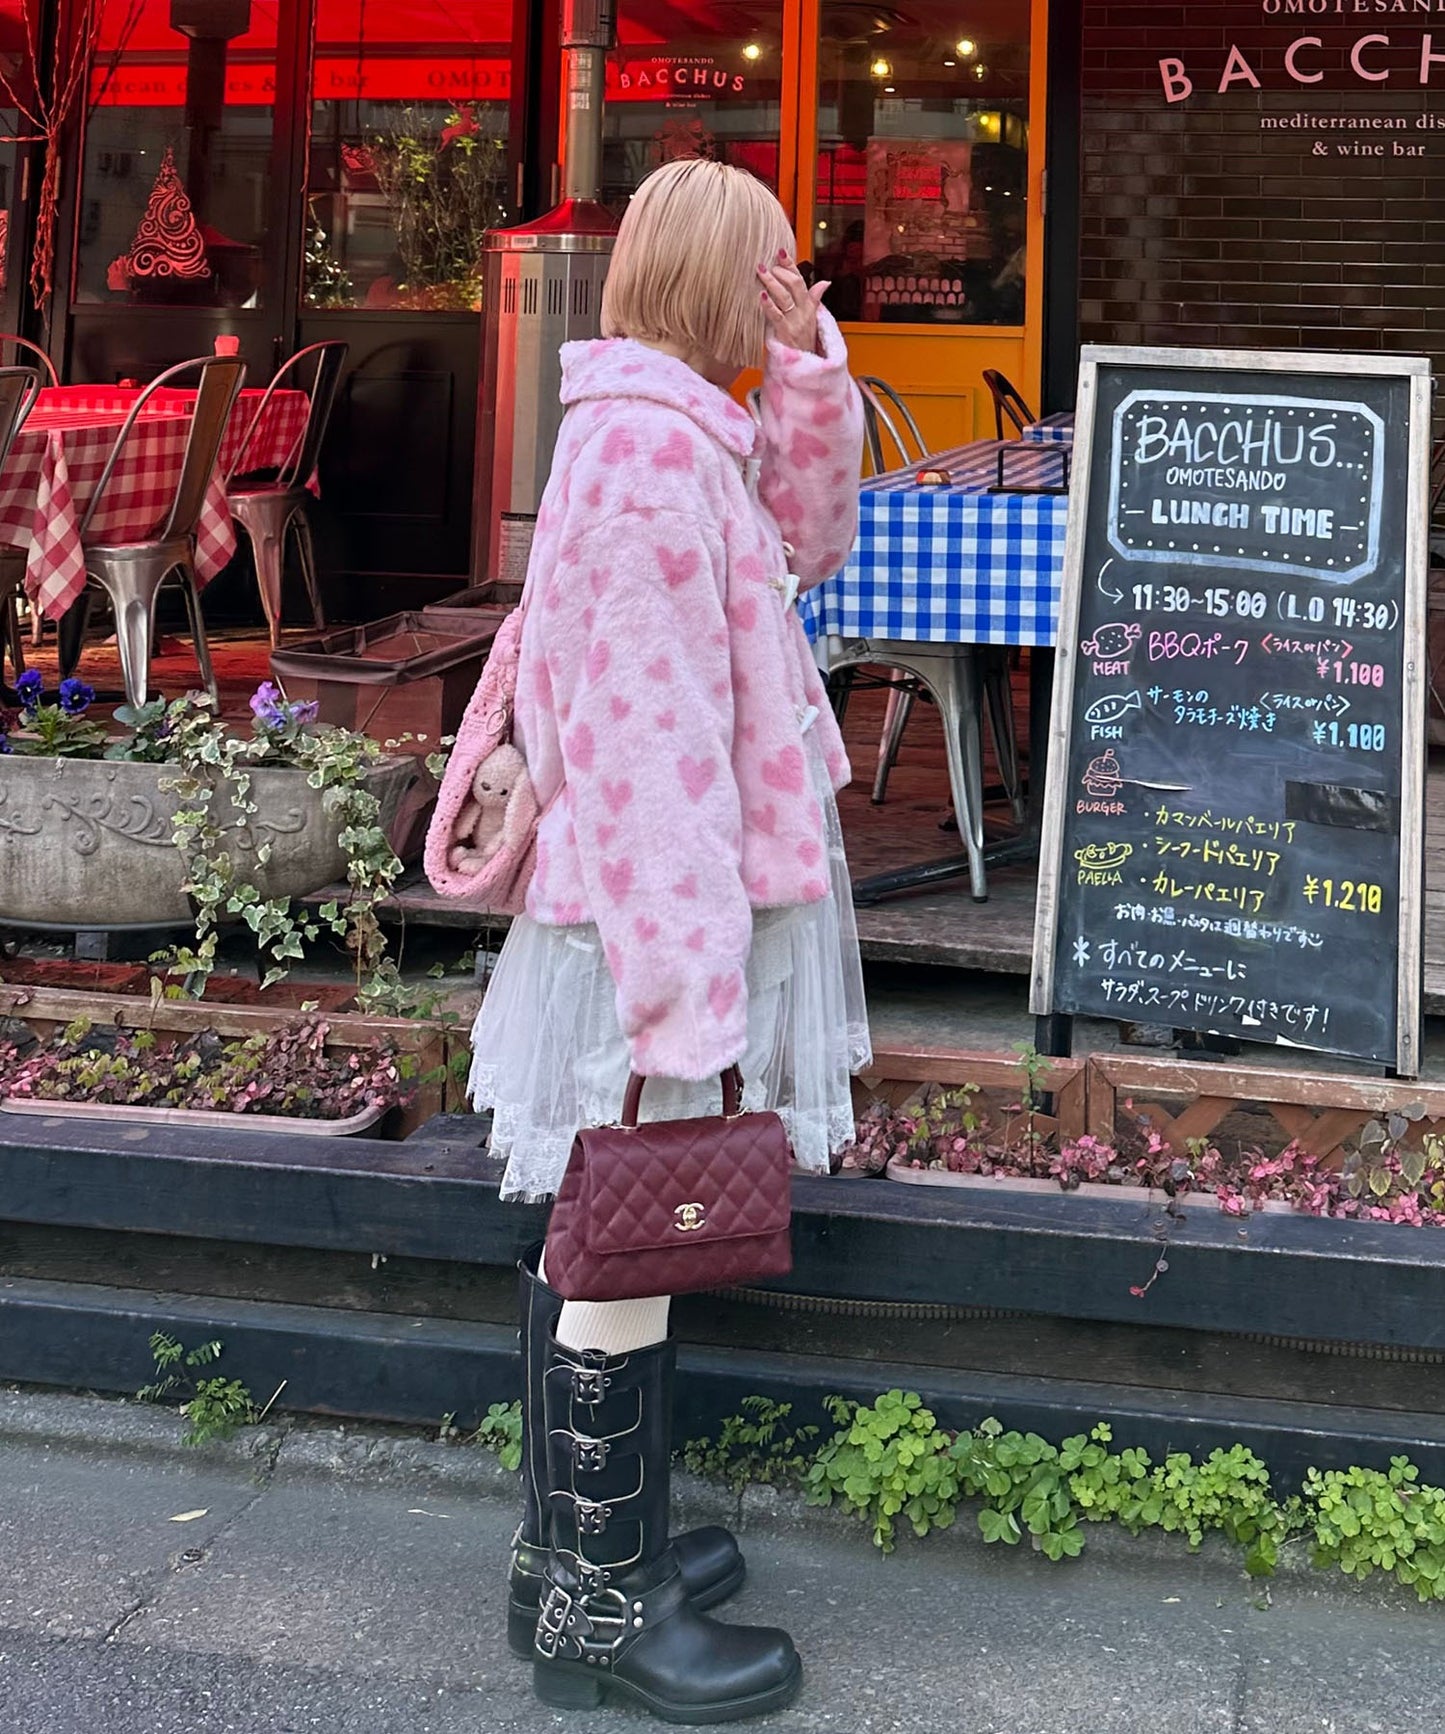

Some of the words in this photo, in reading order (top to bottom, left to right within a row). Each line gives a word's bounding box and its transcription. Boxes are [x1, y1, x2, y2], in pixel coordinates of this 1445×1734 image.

[620, 68, 744, 91] BACCHUS
[1260, 113, 1407, 129] mediterranean
[1312, 140, 1328, 155] &
[1337, 140, 1384, 156] wine
[1392, 140, 1426, 156] bar
[1166, 466, 1287, 491] OMOTESANDO
[1151, 499, 1249, 529] LUNCH
[1260, 505, 1334, 539] TIME
[1092, 660, 1131, 676] MEAT
[1147, 685, 1209, 705] サーモンの
[1090, 725, 1123, 741] FISH
[1076, 800, 1128, 816] BURGER
[1077, 870, 1123, 886] PAELLA
